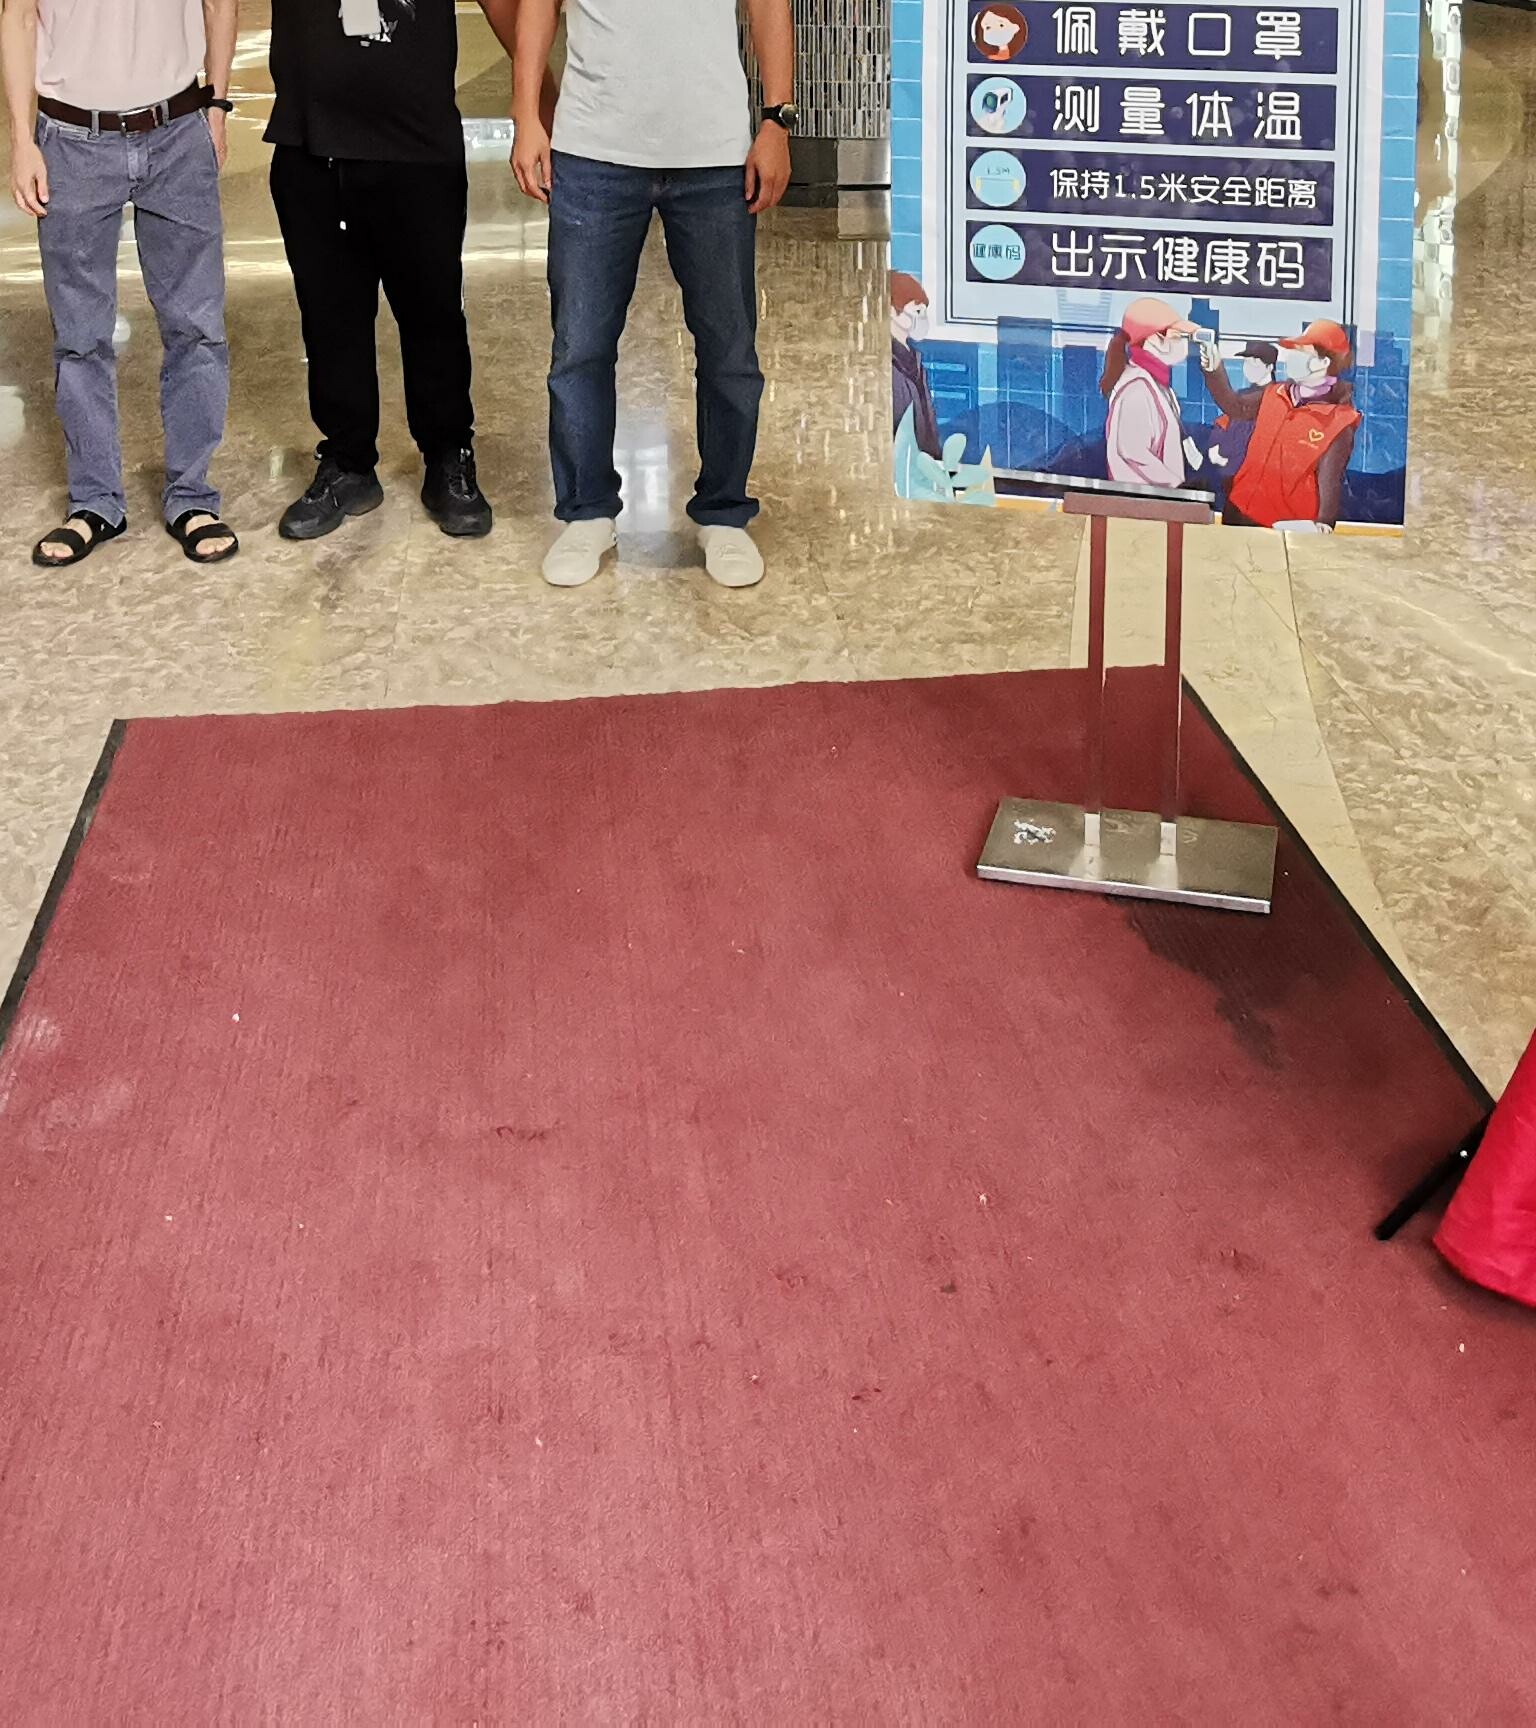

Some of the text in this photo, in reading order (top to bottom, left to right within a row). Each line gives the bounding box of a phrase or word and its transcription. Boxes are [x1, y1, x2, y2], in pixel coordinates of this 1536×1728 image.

[1051, 5, 1304, 60] 佩戴口罩
[1051, 84, 1304, 142] 测量体温
[1049, 168, 1318, 210] 保持1.5米安全距离
[1049, 229, 1306, 290] 出示健康码
